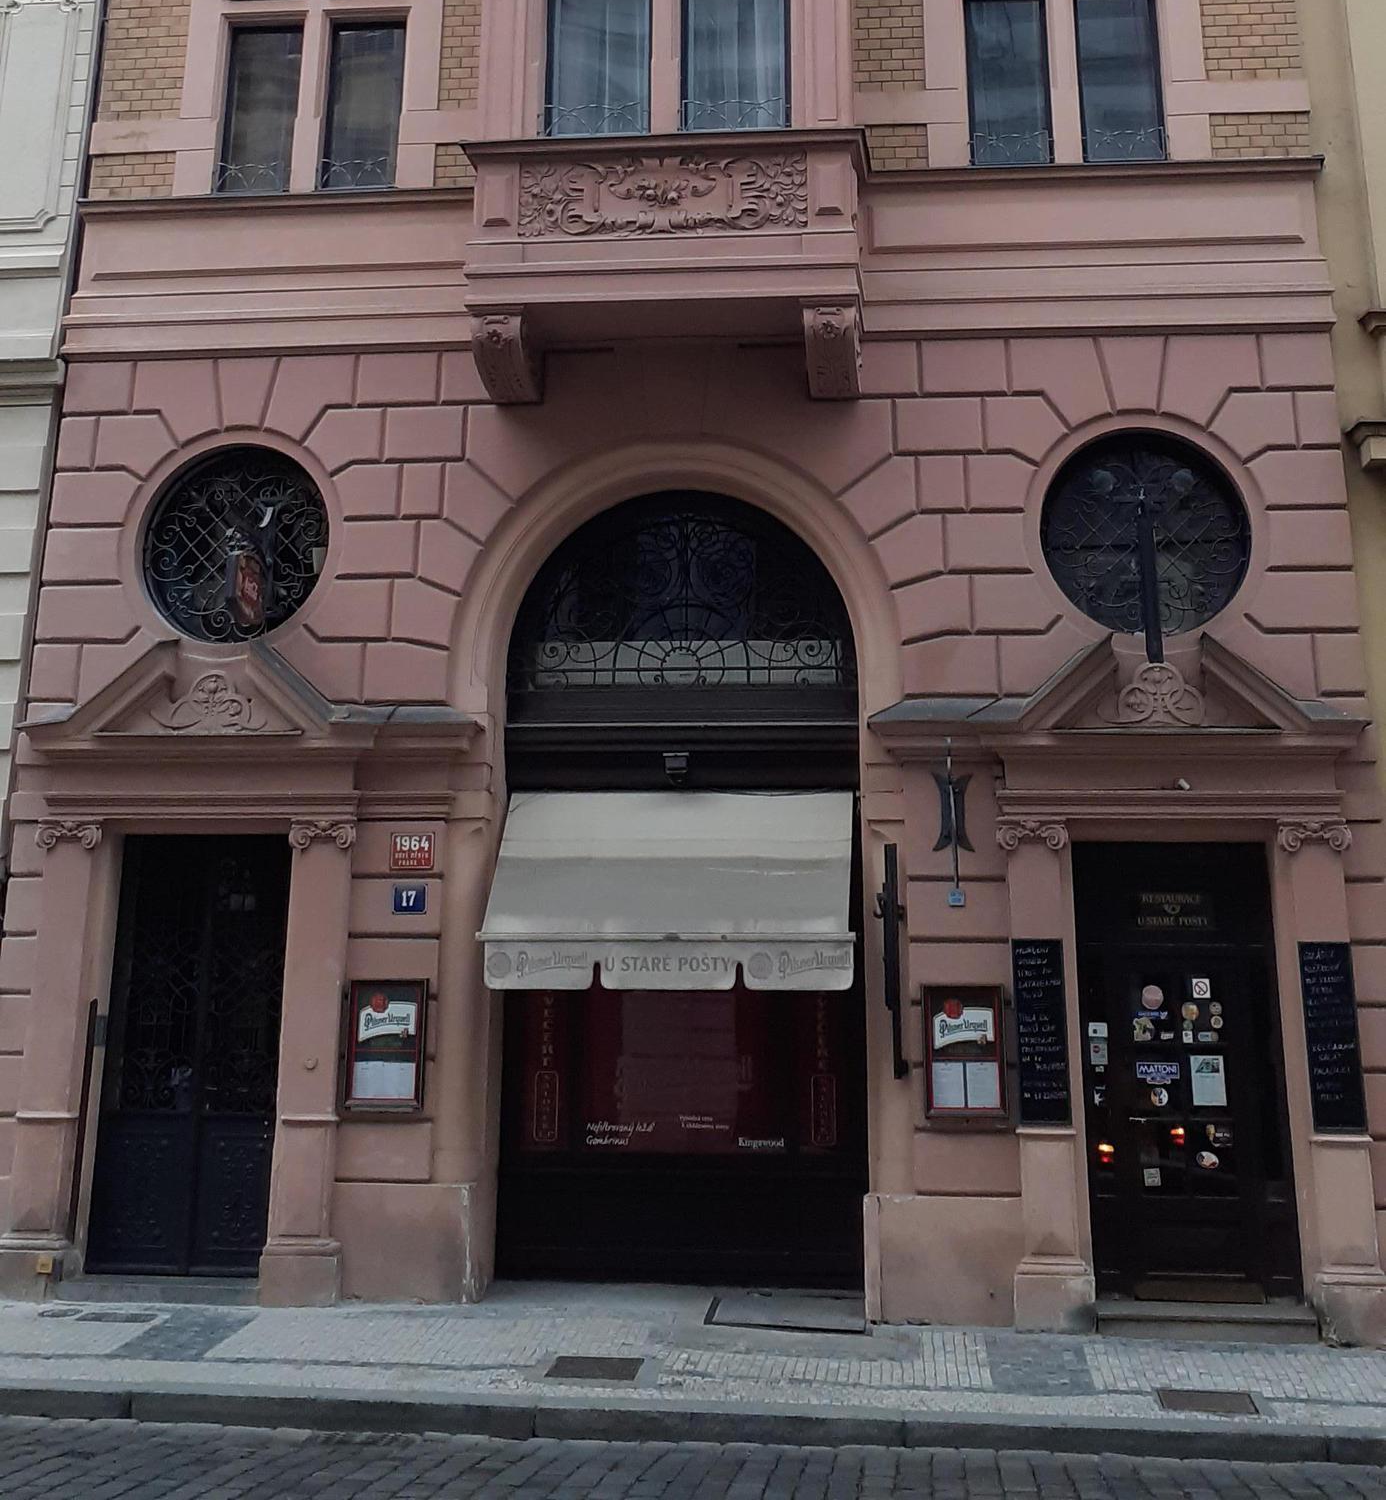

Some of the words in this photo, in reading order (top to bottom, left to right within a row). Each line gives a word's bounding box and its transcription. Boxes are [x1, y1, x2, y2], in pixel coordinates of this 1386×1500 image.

[396, 836, 430, 851] 1964
[402, 890, 417, 907] 17
[604, 957, 615, 972] U
[363, 1012, 388, 1032] Pilsner
[387, 1012, 411, 1027] Urquell
[939, 1019, 964, 1039] Pilsner
[963, 1018, 988, 1033] Urquell
[1138, 1065, 1178, 1074] MATTONI
[585, 1135, 631, 1147] Gambrinus
[738, 1137, 785, 1150] Kingswood
